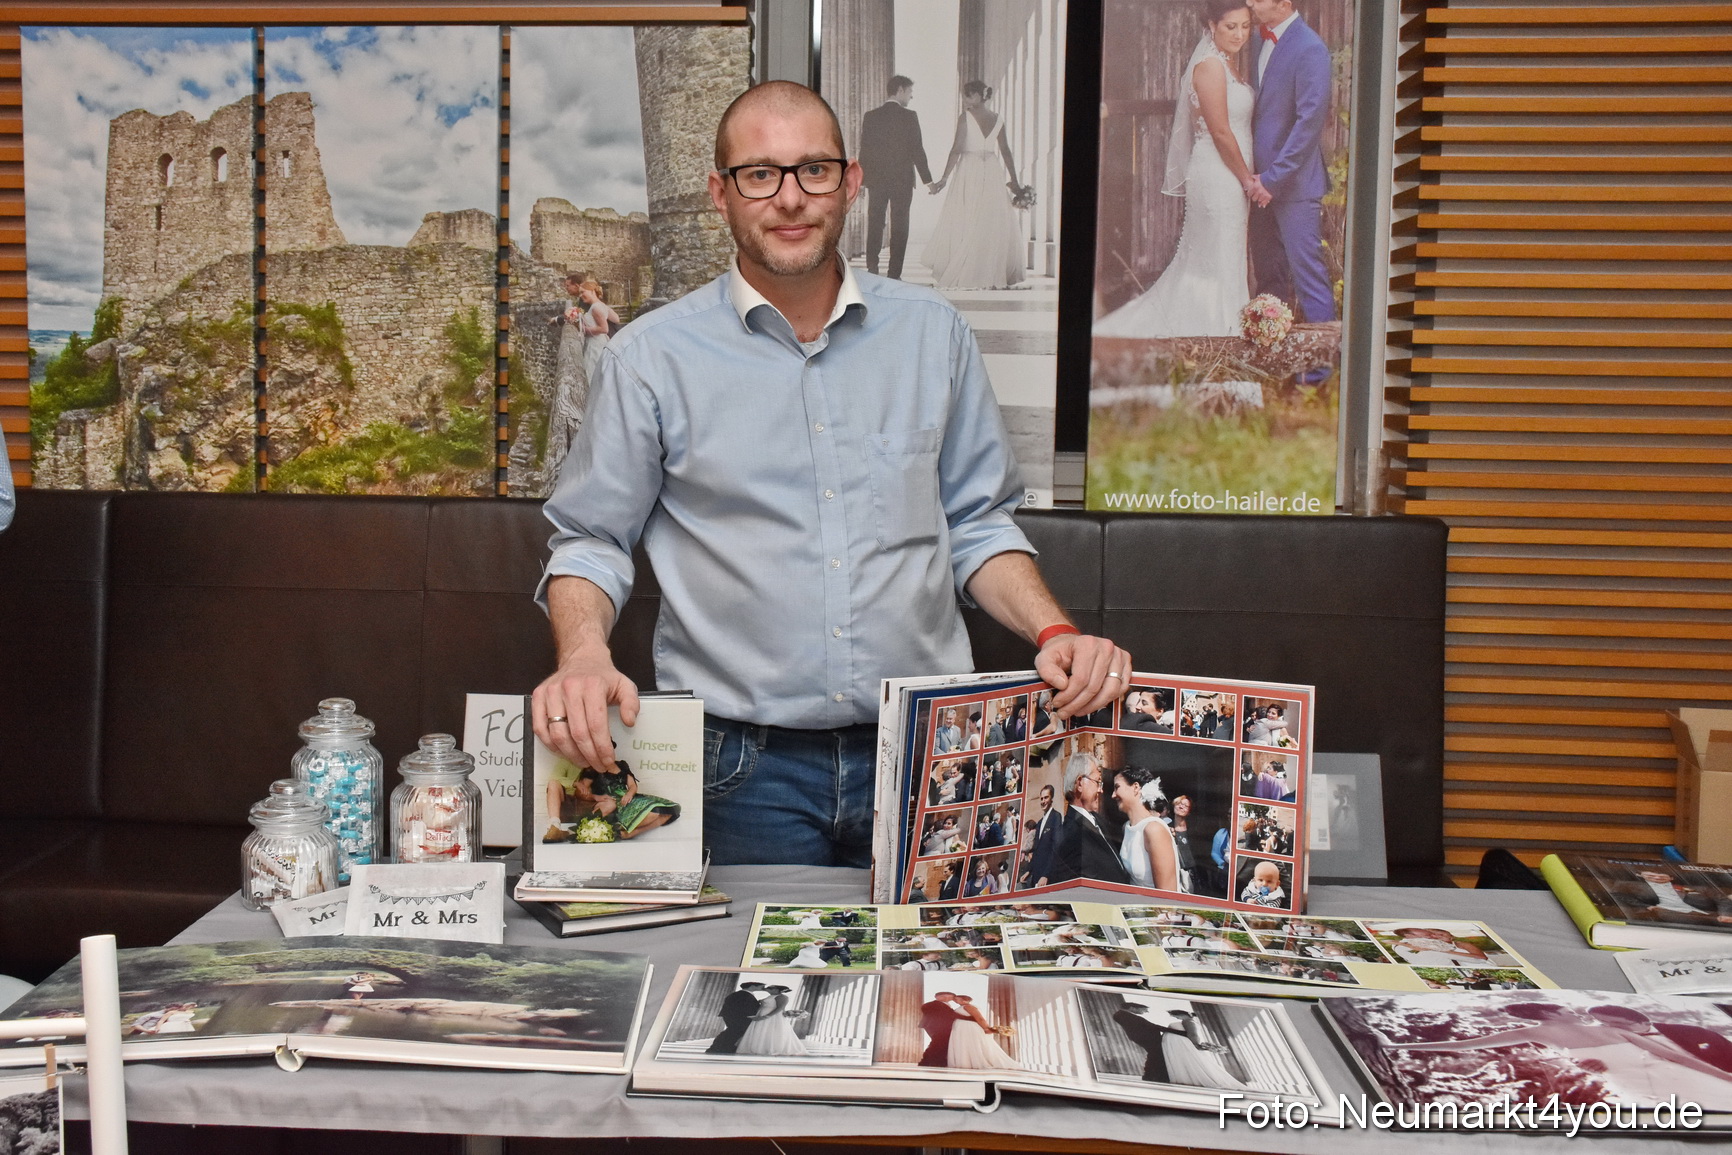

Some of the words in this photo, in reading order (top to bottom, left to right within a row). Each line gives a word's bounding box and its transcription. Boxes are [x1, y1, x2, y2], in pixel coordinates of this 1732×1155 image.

[1104, 488, 1321, 512] www.foto-hailer.de
[632, 739, 678, 752] Unsere
[640, 759, 697, 773] Hochzeit
[308, 910, 338, 926] Mr
[373, 911, 403, 928] Mr
[411, 910, 430, 925] &
[437, 909, 478, 925] Mrs
[1659, 967, 1693, 978] Mr
[1704, 965, 1727, 974] &
